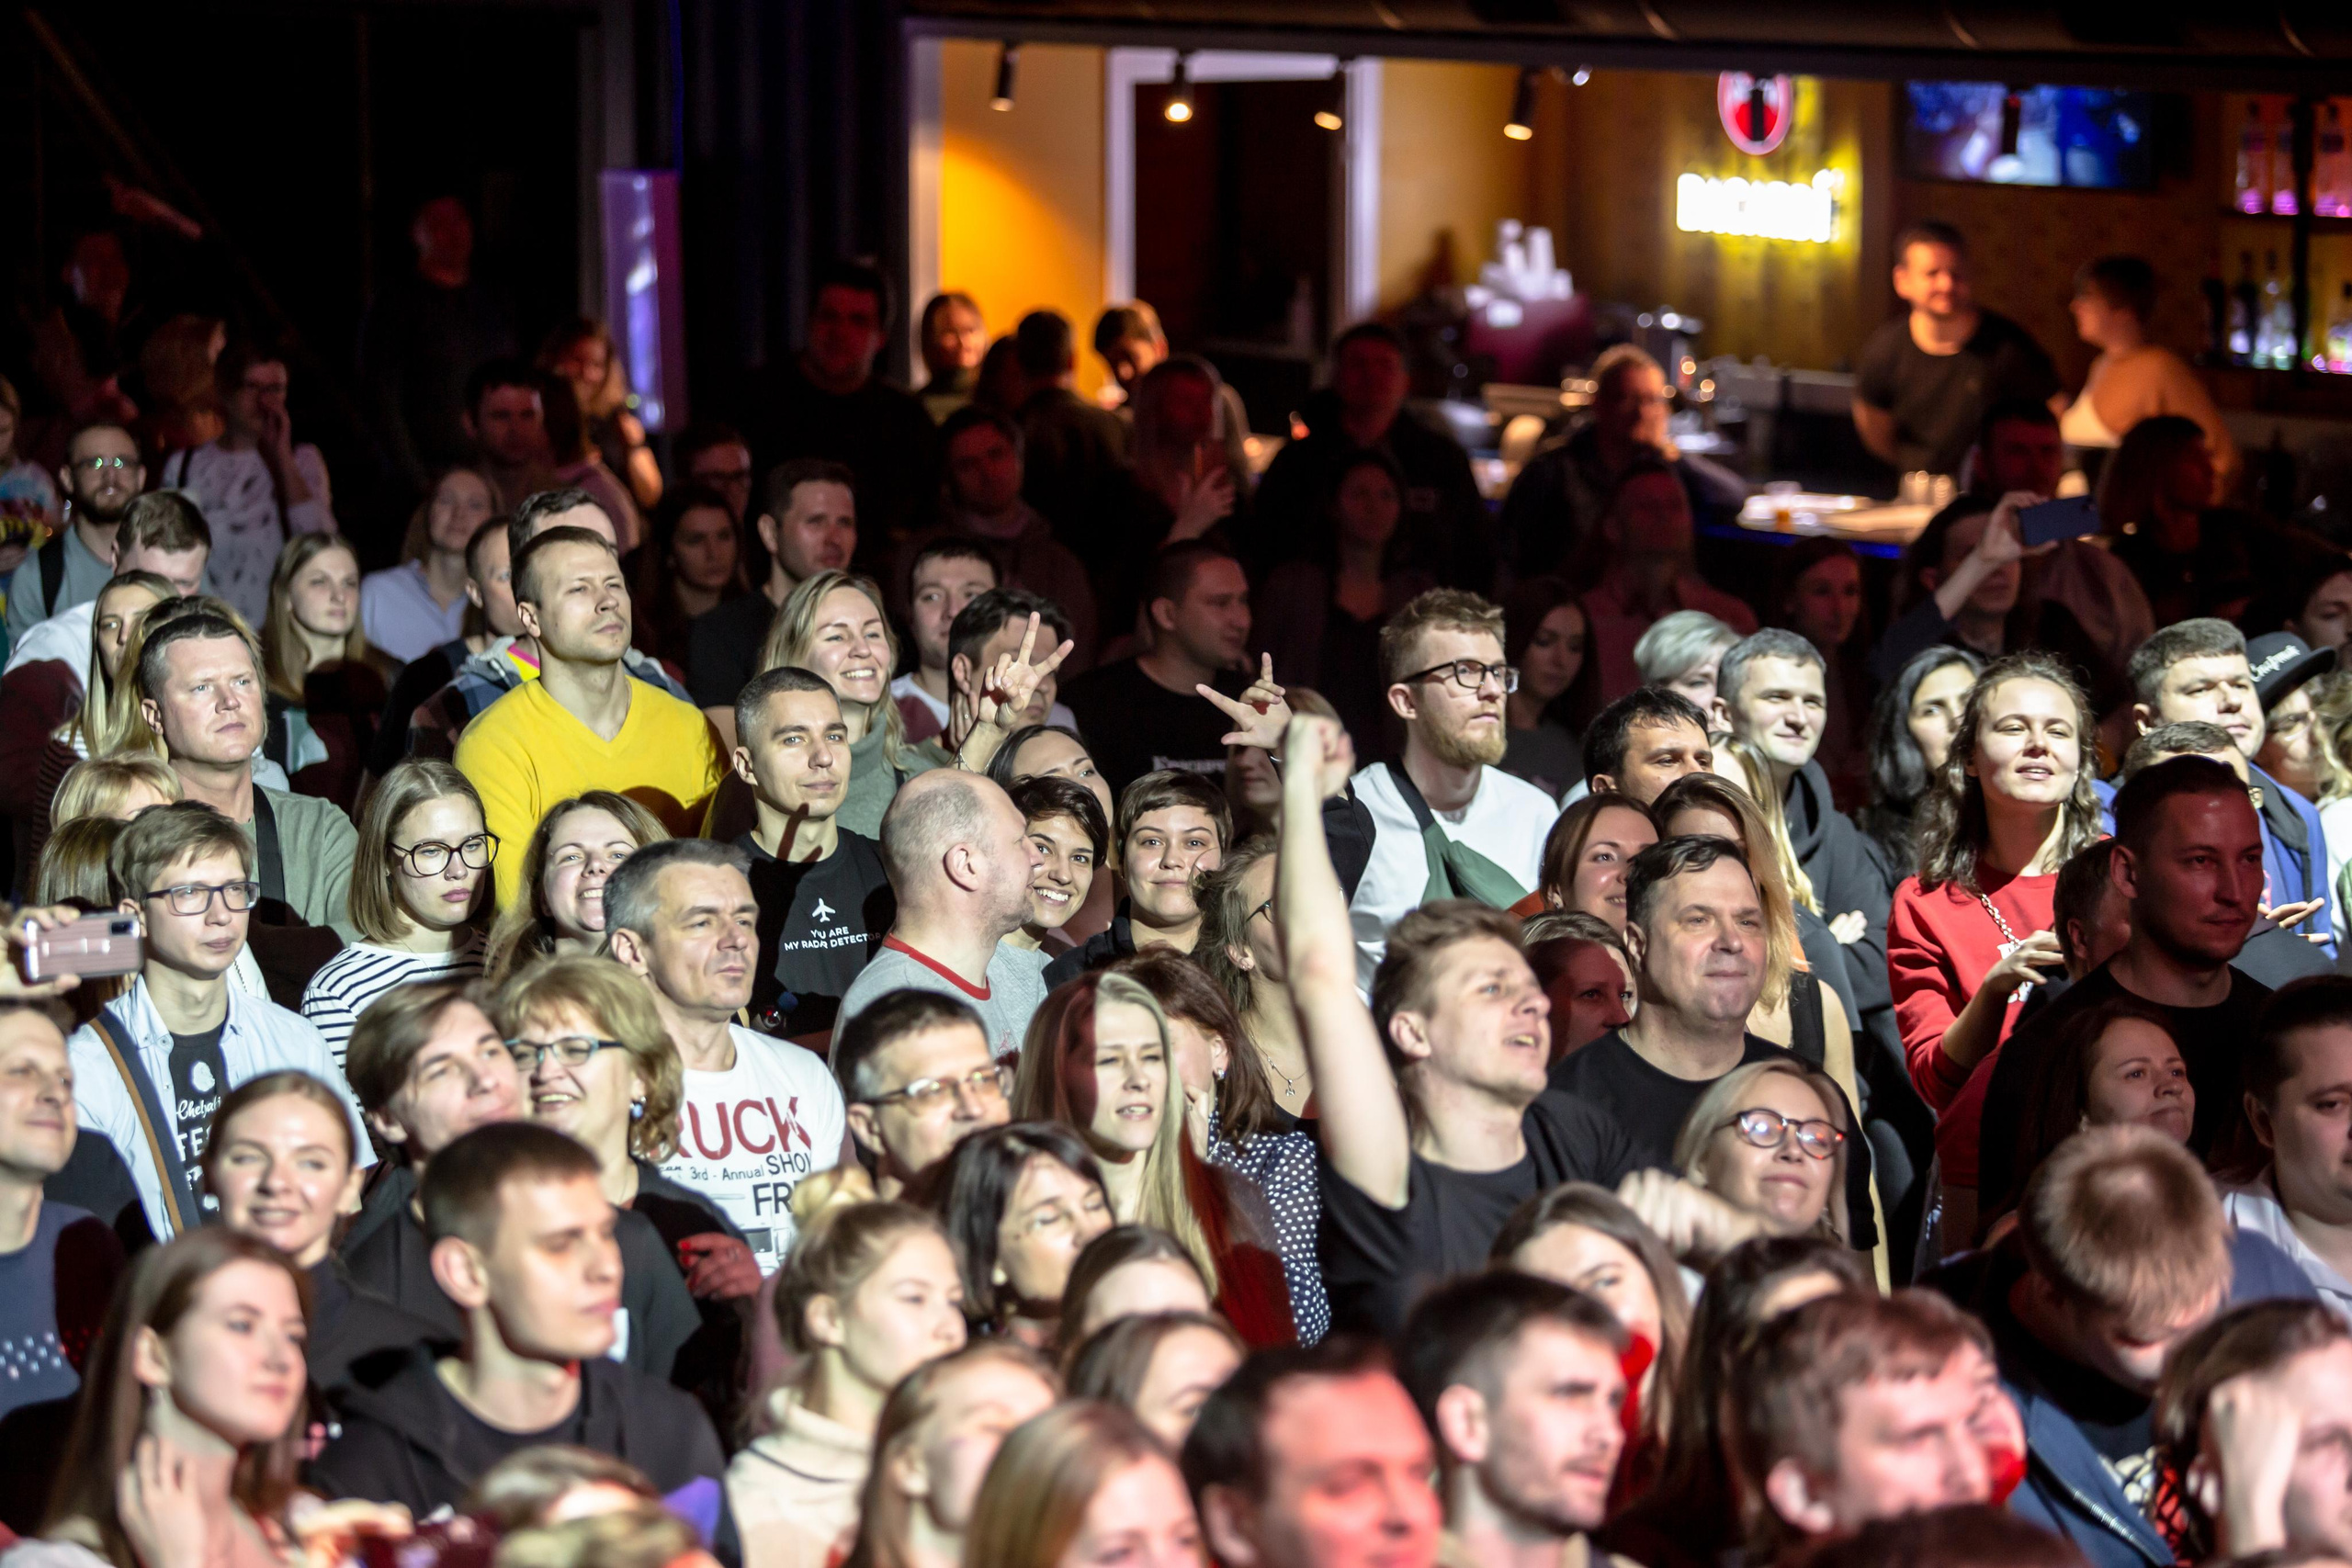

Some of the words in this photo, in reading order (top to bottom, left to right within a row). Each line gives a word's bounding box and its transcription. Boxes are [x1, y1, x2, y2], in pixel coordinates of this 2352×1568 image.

[829, 926, 850, 938] ARE
[784, 941, 799, 952] MY
[690, 1166, 709, 1181] 3rd
[721, 1164, 765, 1181] Annual
[752, 1180, 799, 1217] FR
